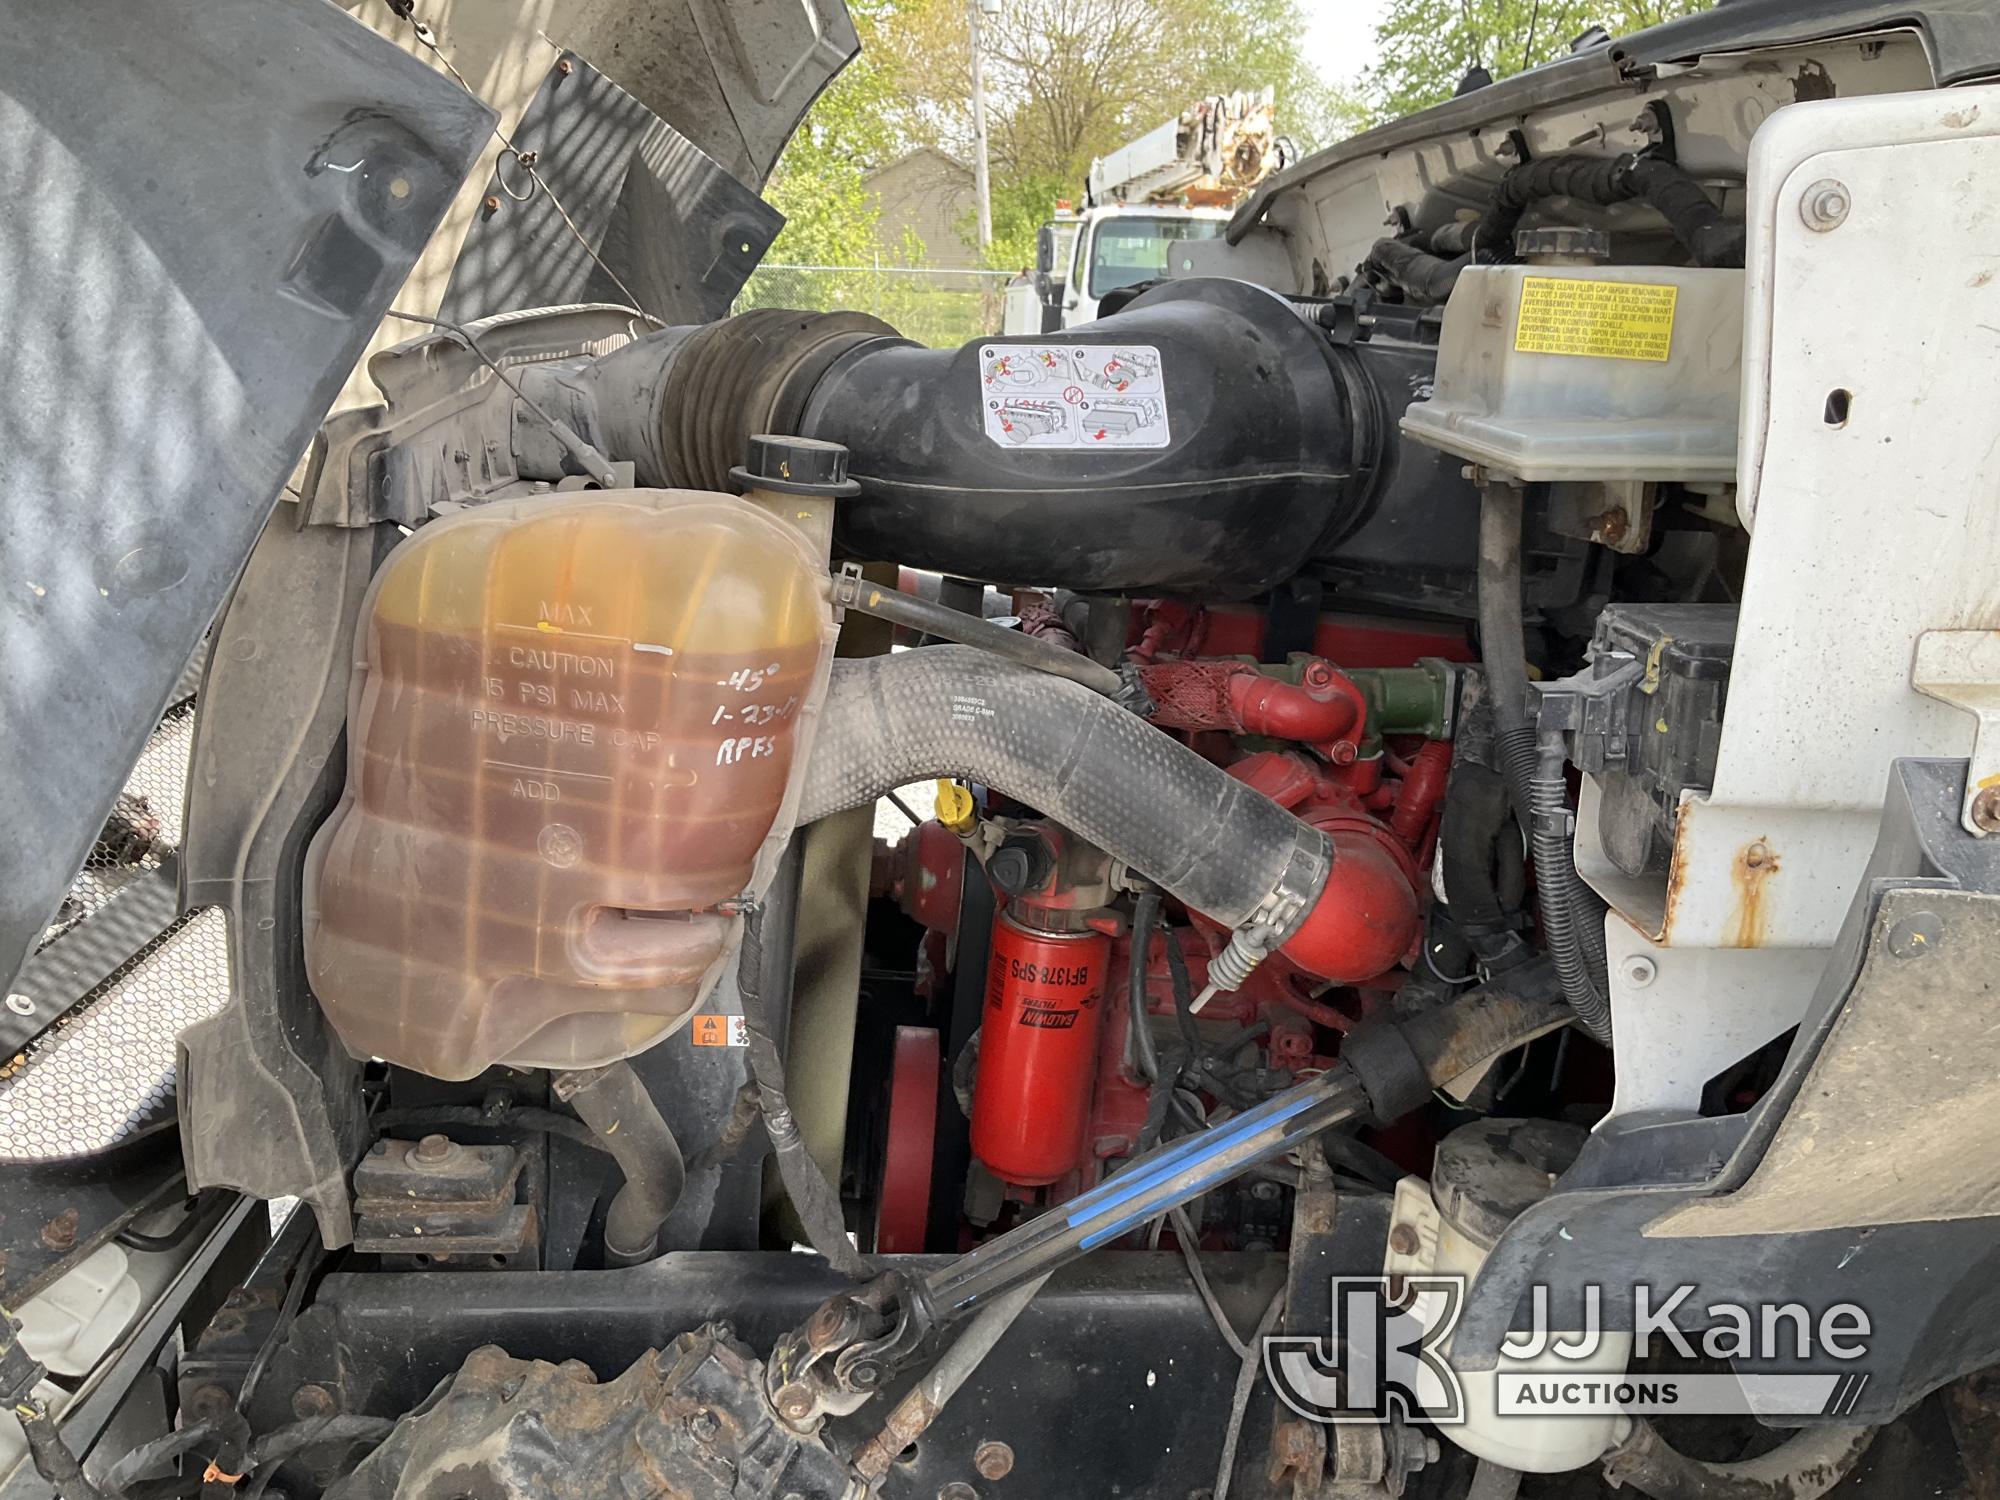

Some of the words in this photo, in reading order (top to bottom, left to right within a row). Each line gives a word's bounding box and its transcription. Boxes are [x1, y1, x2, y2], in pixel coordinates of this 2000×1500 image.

[1578, 302, 1608, 310] NETTOYER
[1622, 304, 1650, 313] BOUCHON
[1522, 316, 1551, 324] PROVENANT
[1567, 318, 1598, 327] CONTENANT
[1555, 343, 1586, 352] RECIPIENTE
[1644, 340, 1667, 349] FRENOS
[538, 600, 593, 627] MAX
[511, 646, 614, 679] CAUTION
[483, 675, 505, 698] 15
[519, 681, 557, 706] PSI
[571, 688, 626, 714] MAX
[471, 709, 595, 747] PRESSURE
[608, 727, 662, 753] CAP
[511, 778, 561, 802] ADD
[1022, 997, 1058, 1010] FILTERS
[1023, 1011, 1076, 1027] BALDWIN
